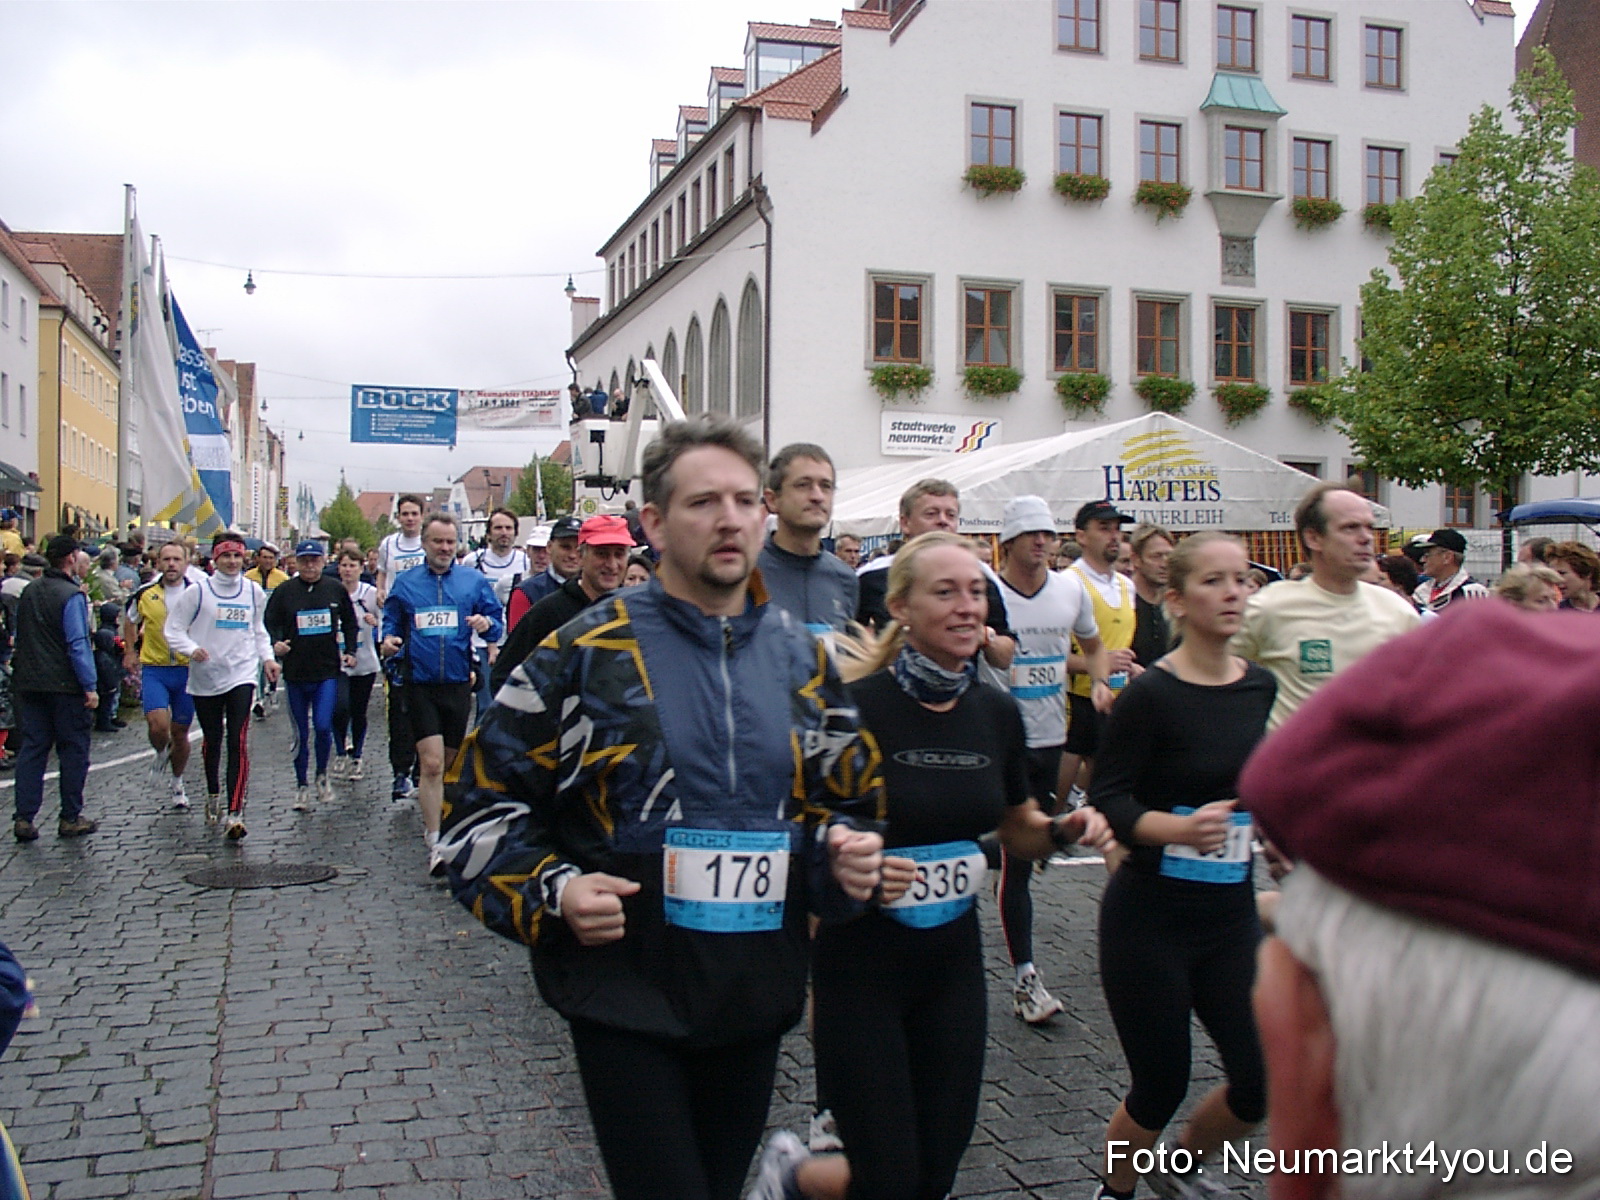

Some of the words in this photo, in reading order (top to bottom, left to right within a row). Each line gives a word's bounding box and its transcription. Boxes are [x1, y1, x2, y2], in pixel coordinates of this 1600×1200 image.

[181, 371, 197, 391] ist
[358, 388, 450, 412] BOCK
[890, 420, 957, 434] stadtwerke
[888, 433, 944, 445] neumarkt
[1102, 465, 1222, 502] HÄRTEIS
[1269, 511, 1291, 524] Tel:
[226, 608, 245, 621] 289
[307, 615, 326, 627] 394
[427, 612, 450, 626] 267
[1028, 666, 1056, 685] 580
[671, 831, 732, 848] BOCK
[706, 853, 771, 899] 178
[913, 860, 969, 901] 336
